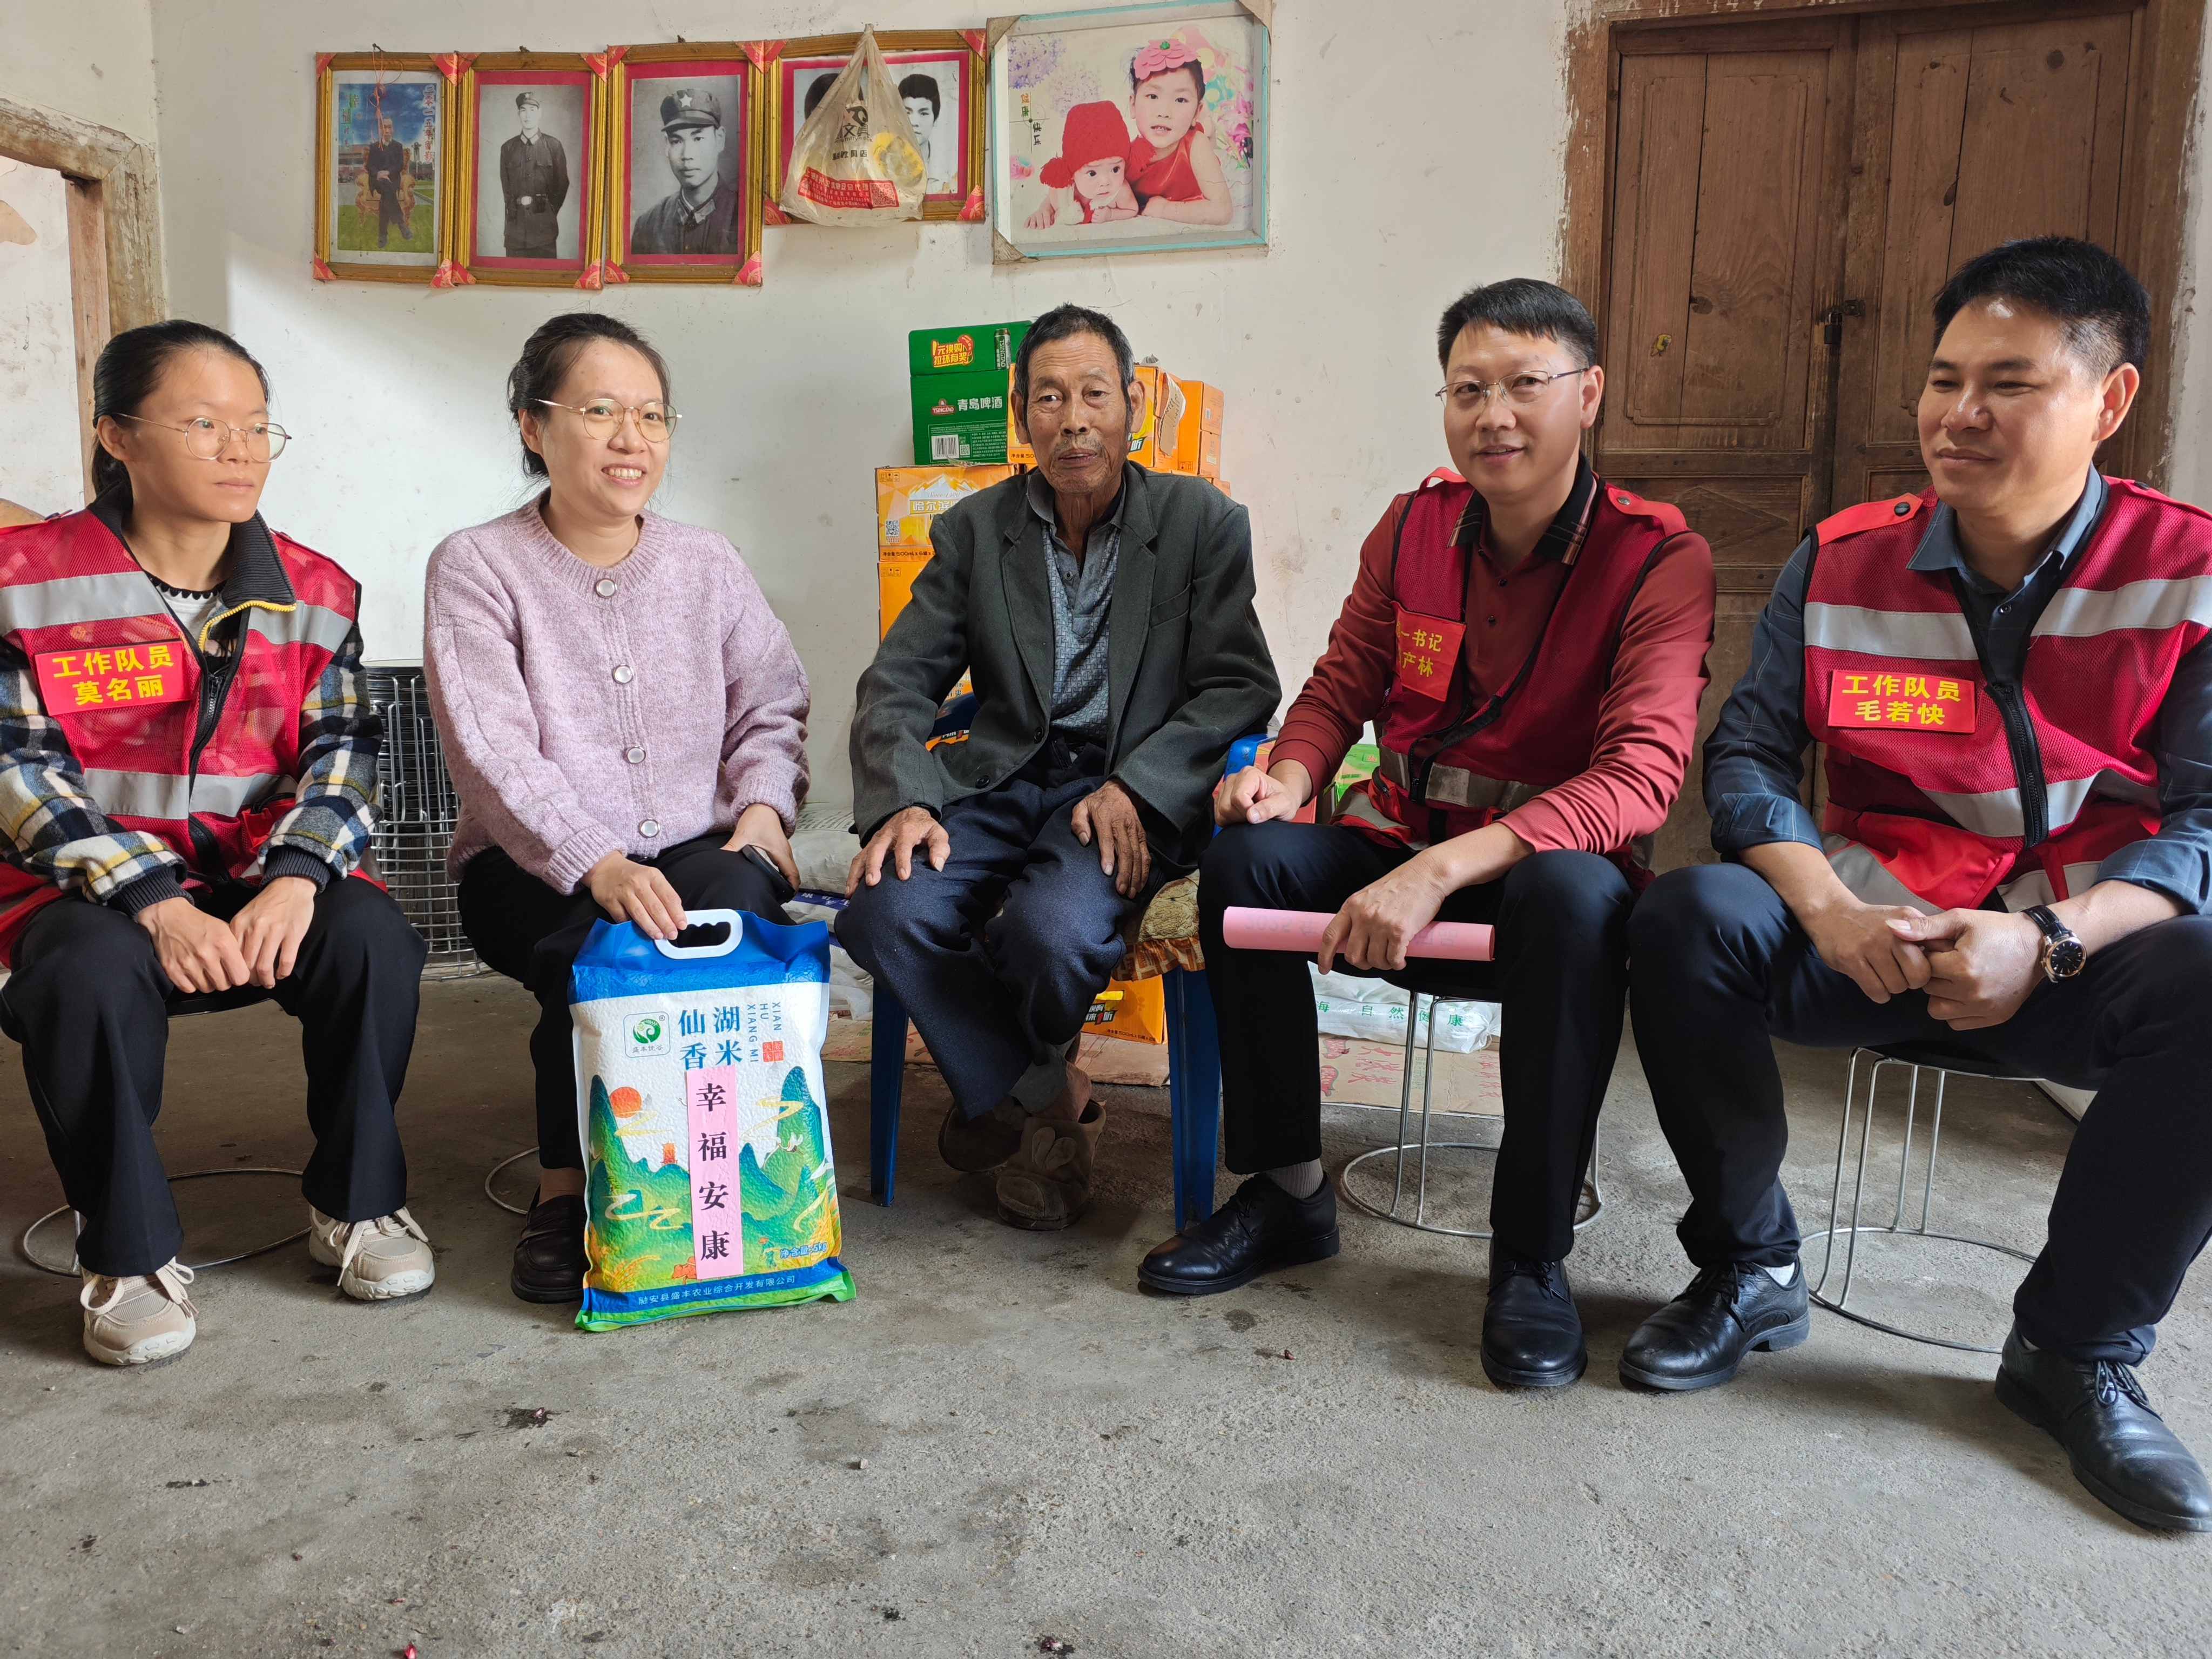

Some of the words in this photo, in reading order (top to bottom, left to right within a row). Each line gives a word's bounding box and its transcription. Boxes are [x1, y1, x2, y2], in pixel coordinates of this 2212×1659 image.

[1398, 626, 1443, 652] 一书记
[52, 645, 174, 678] 工作队员
[72, 675, 164, 706] 莫名丽
[1842, 675, 1961, 702] 工作队员
[1855, 699, 1945, 725] 毛若快
[678, 1006, 740, 1036] 仙湖
[747, 1004, 758, 1042] XIANG
[760, 1003, 769, 1020] HU
[772, 1002, 782, 1030] XIAN
[679, 1040, 743, 1070] 香米
[750, 1049, 759, 1062] MI
[696, 1083, 730, 1260] 幸福安康
[638, 1275, 795, 1305] 融安县盛丰农业综合开发有限公司
